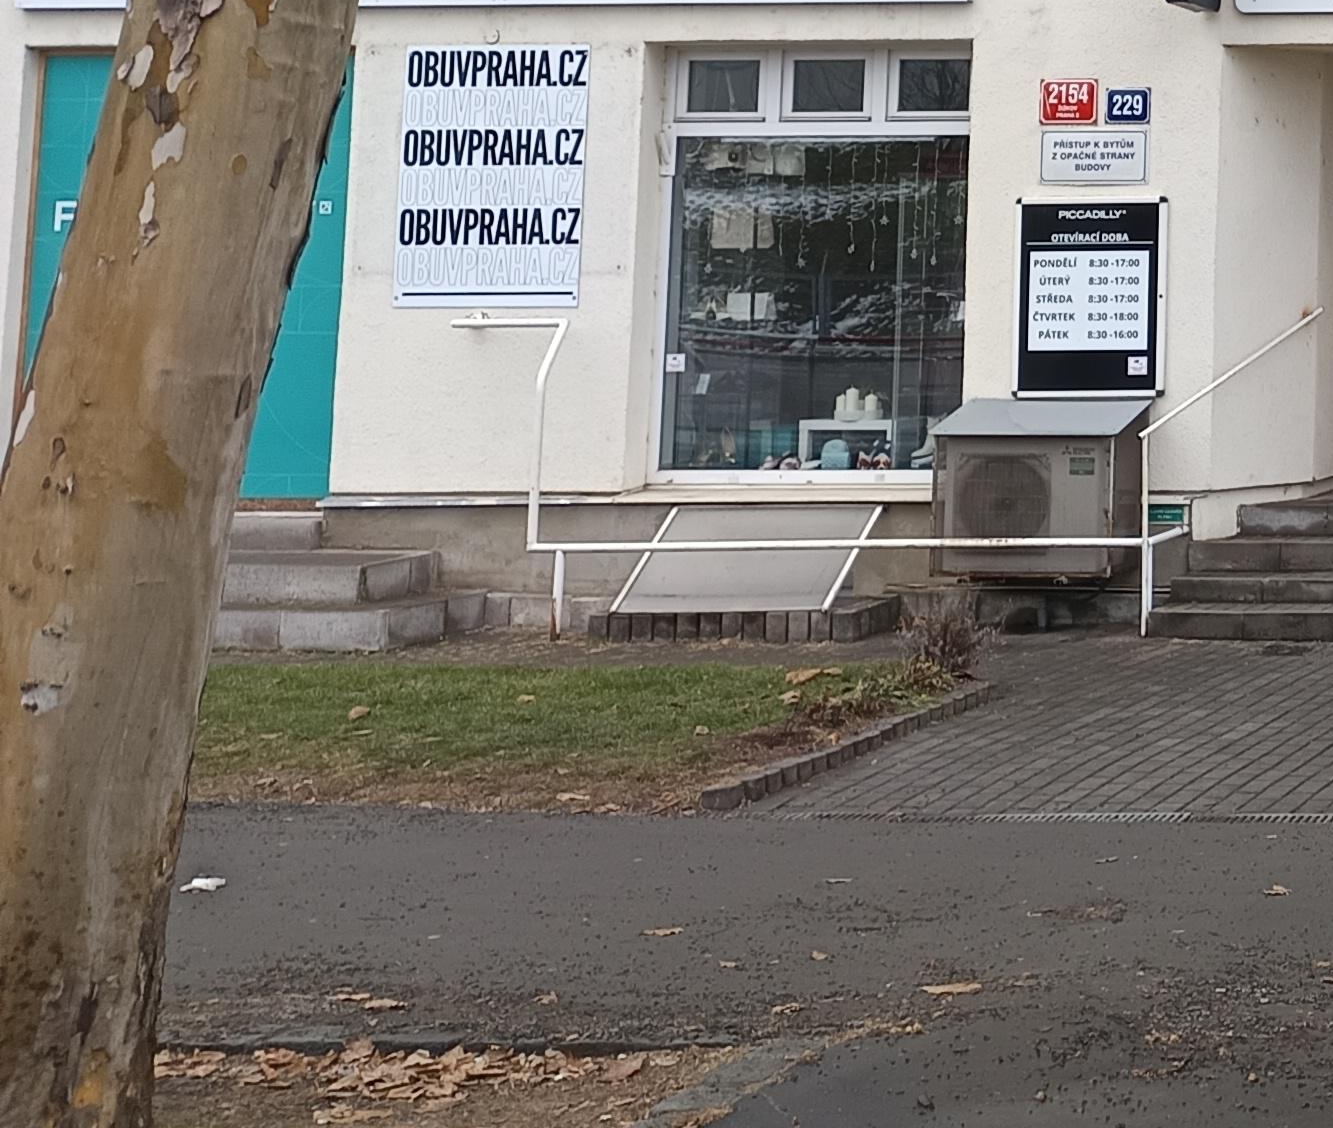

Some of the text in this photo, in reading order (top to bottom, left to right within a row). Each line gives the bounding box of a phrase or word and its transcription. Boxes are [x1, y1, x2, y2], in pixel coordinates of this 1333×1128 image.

[408, 50, 588, 87] OBUVPRAHA.CZ
[1048, 83, 1089, 104] 2154
[405, 89, 586, 127] OBUVPRAHA.CZ
[1112, 94, 1143, 116] 229
[403, 129, 584, 166] OBUVPRAHA.CZ
[1053, 139, 1091, 149] PŘÍSTUP
[1103, 139, 1134, 148] BYTŮM
[1060, 150, 1097, 160] OPAČNÉ
[1100, 152, 1135, 160] STRANY
[1075, 163, 1111, 171] BUDOVY
[401, 168, 583, 207] OBUVPRAHA.CZ
[1058, 210, 1122, 219] PICCADILLY
[399, 208, 581, 246] OBUVPRAHA.CZ
[1051, 231, 1129, 242] OTEVÍRACÍ DOBA
[397, 246, 578, 286] OBUVPRAHA.CZ
[1033, 257, 1077, 268] PONDĚLÍ
[1089, 259, 1109, 267] 8:30
[1039, 275, 1070, 285] ÚTERÝ
[1088, 277, 1108, 285] 8:30
[1036, 292, 1073, 303] STŘEDA
[1088, 295, 1108, 303] 8:30
[1032, 311, 1075, 321] ČTVRTEK
[1087, 313, 1107, 321] 8:30
[1038, 329, 1069, 339] PÁTEK
[1087, 331, 1107, 339] 8:30
